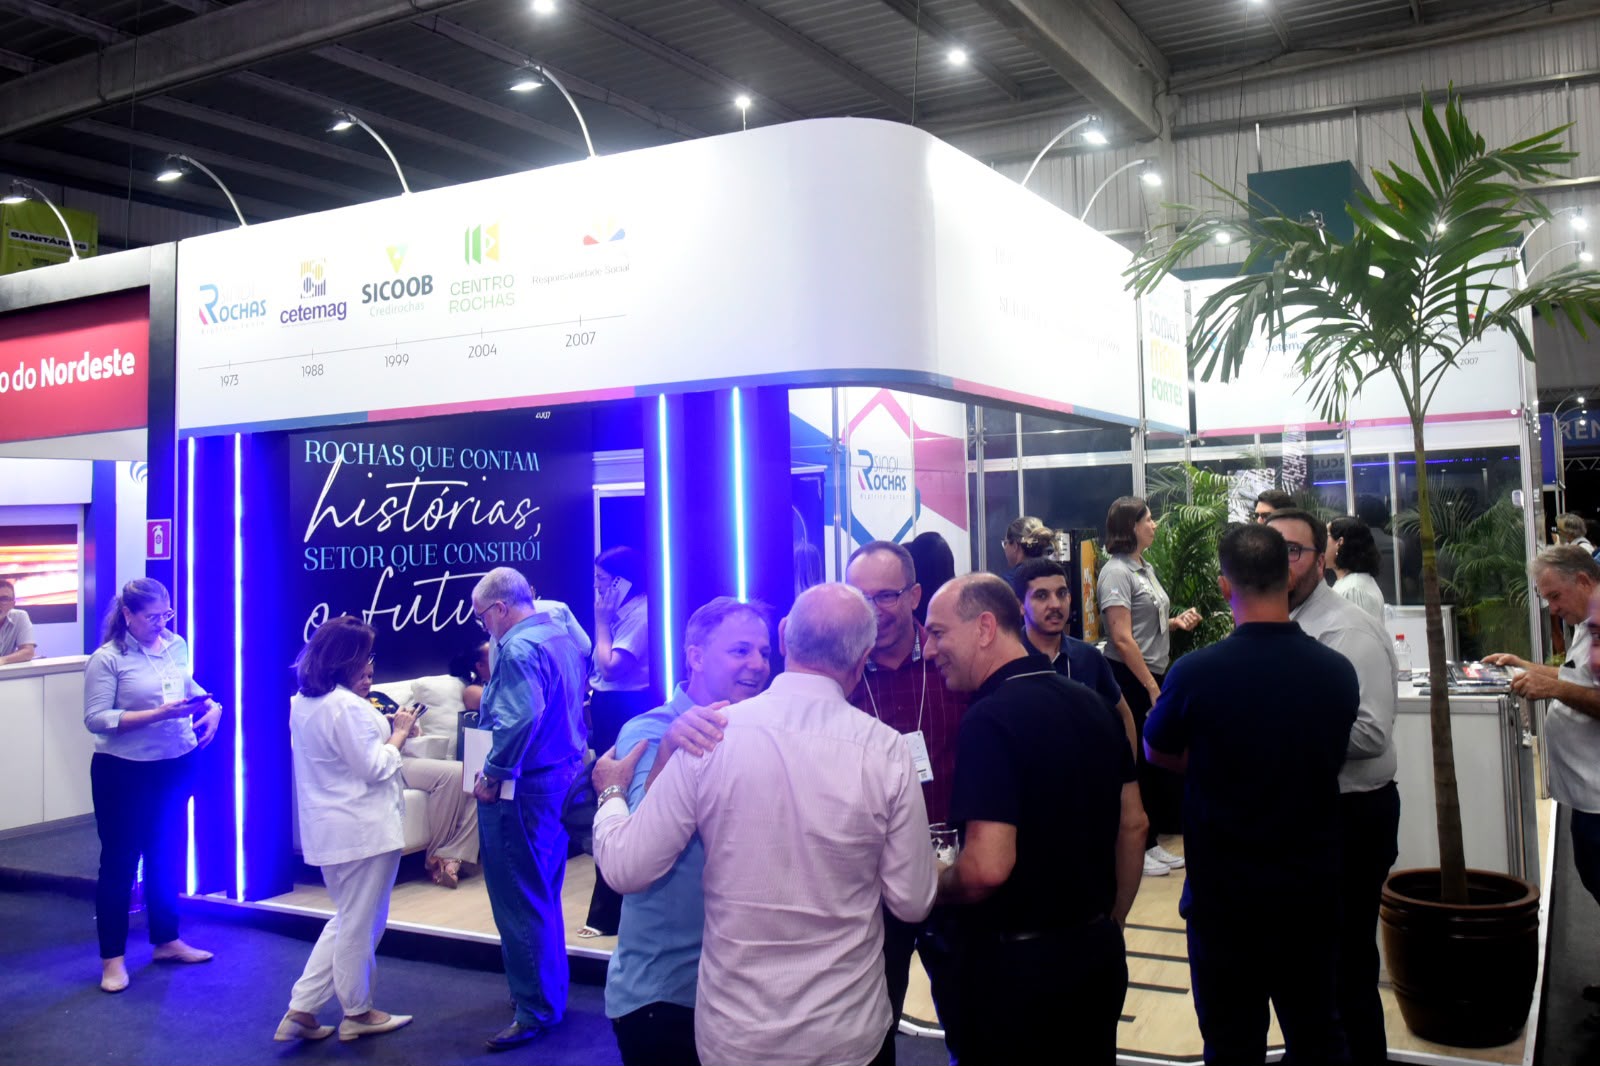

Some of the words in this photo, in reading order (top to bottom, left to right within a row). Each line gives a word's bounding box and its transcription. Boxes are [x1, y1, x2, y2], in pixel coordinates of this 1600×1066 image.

[362, 274, 433, 304] SICOOB
[450, 274, 515, 296] CENTRO
[198, 283, 267, 326] ROCHAS
[280, 301, 347, 325] cetemag
[369, 301, 425, 318] Credirochas
[449, 292, 516, 314] ROCHAS
[565, 331, 597, 348] 2007
[384, 353, 410, 368] 1999
[468, 344, 497, 359] 2004
[1460, 357, 1479, 366] 2007
[12, 361, 37, 391] do
[40, 348, 136, 387] Nordeste
[221, 374, 239, 387] 1973
[301, 364, 324, 377] 1988
[304, 439, 405, 467] ROCHAS
[410, 446, 455, 473] QUE
[460, 448, 541, 473] CONTAM
[857, 449, 907, 491] ROCHAS
[303, 453, 542, 543] histórias,
[304, 545, 385, 572] SETOR
[390, 543, 438, 573] QUE
[443, 536, 542, 564] CONSTRÓI
[362, 565, 490, 632] futu
